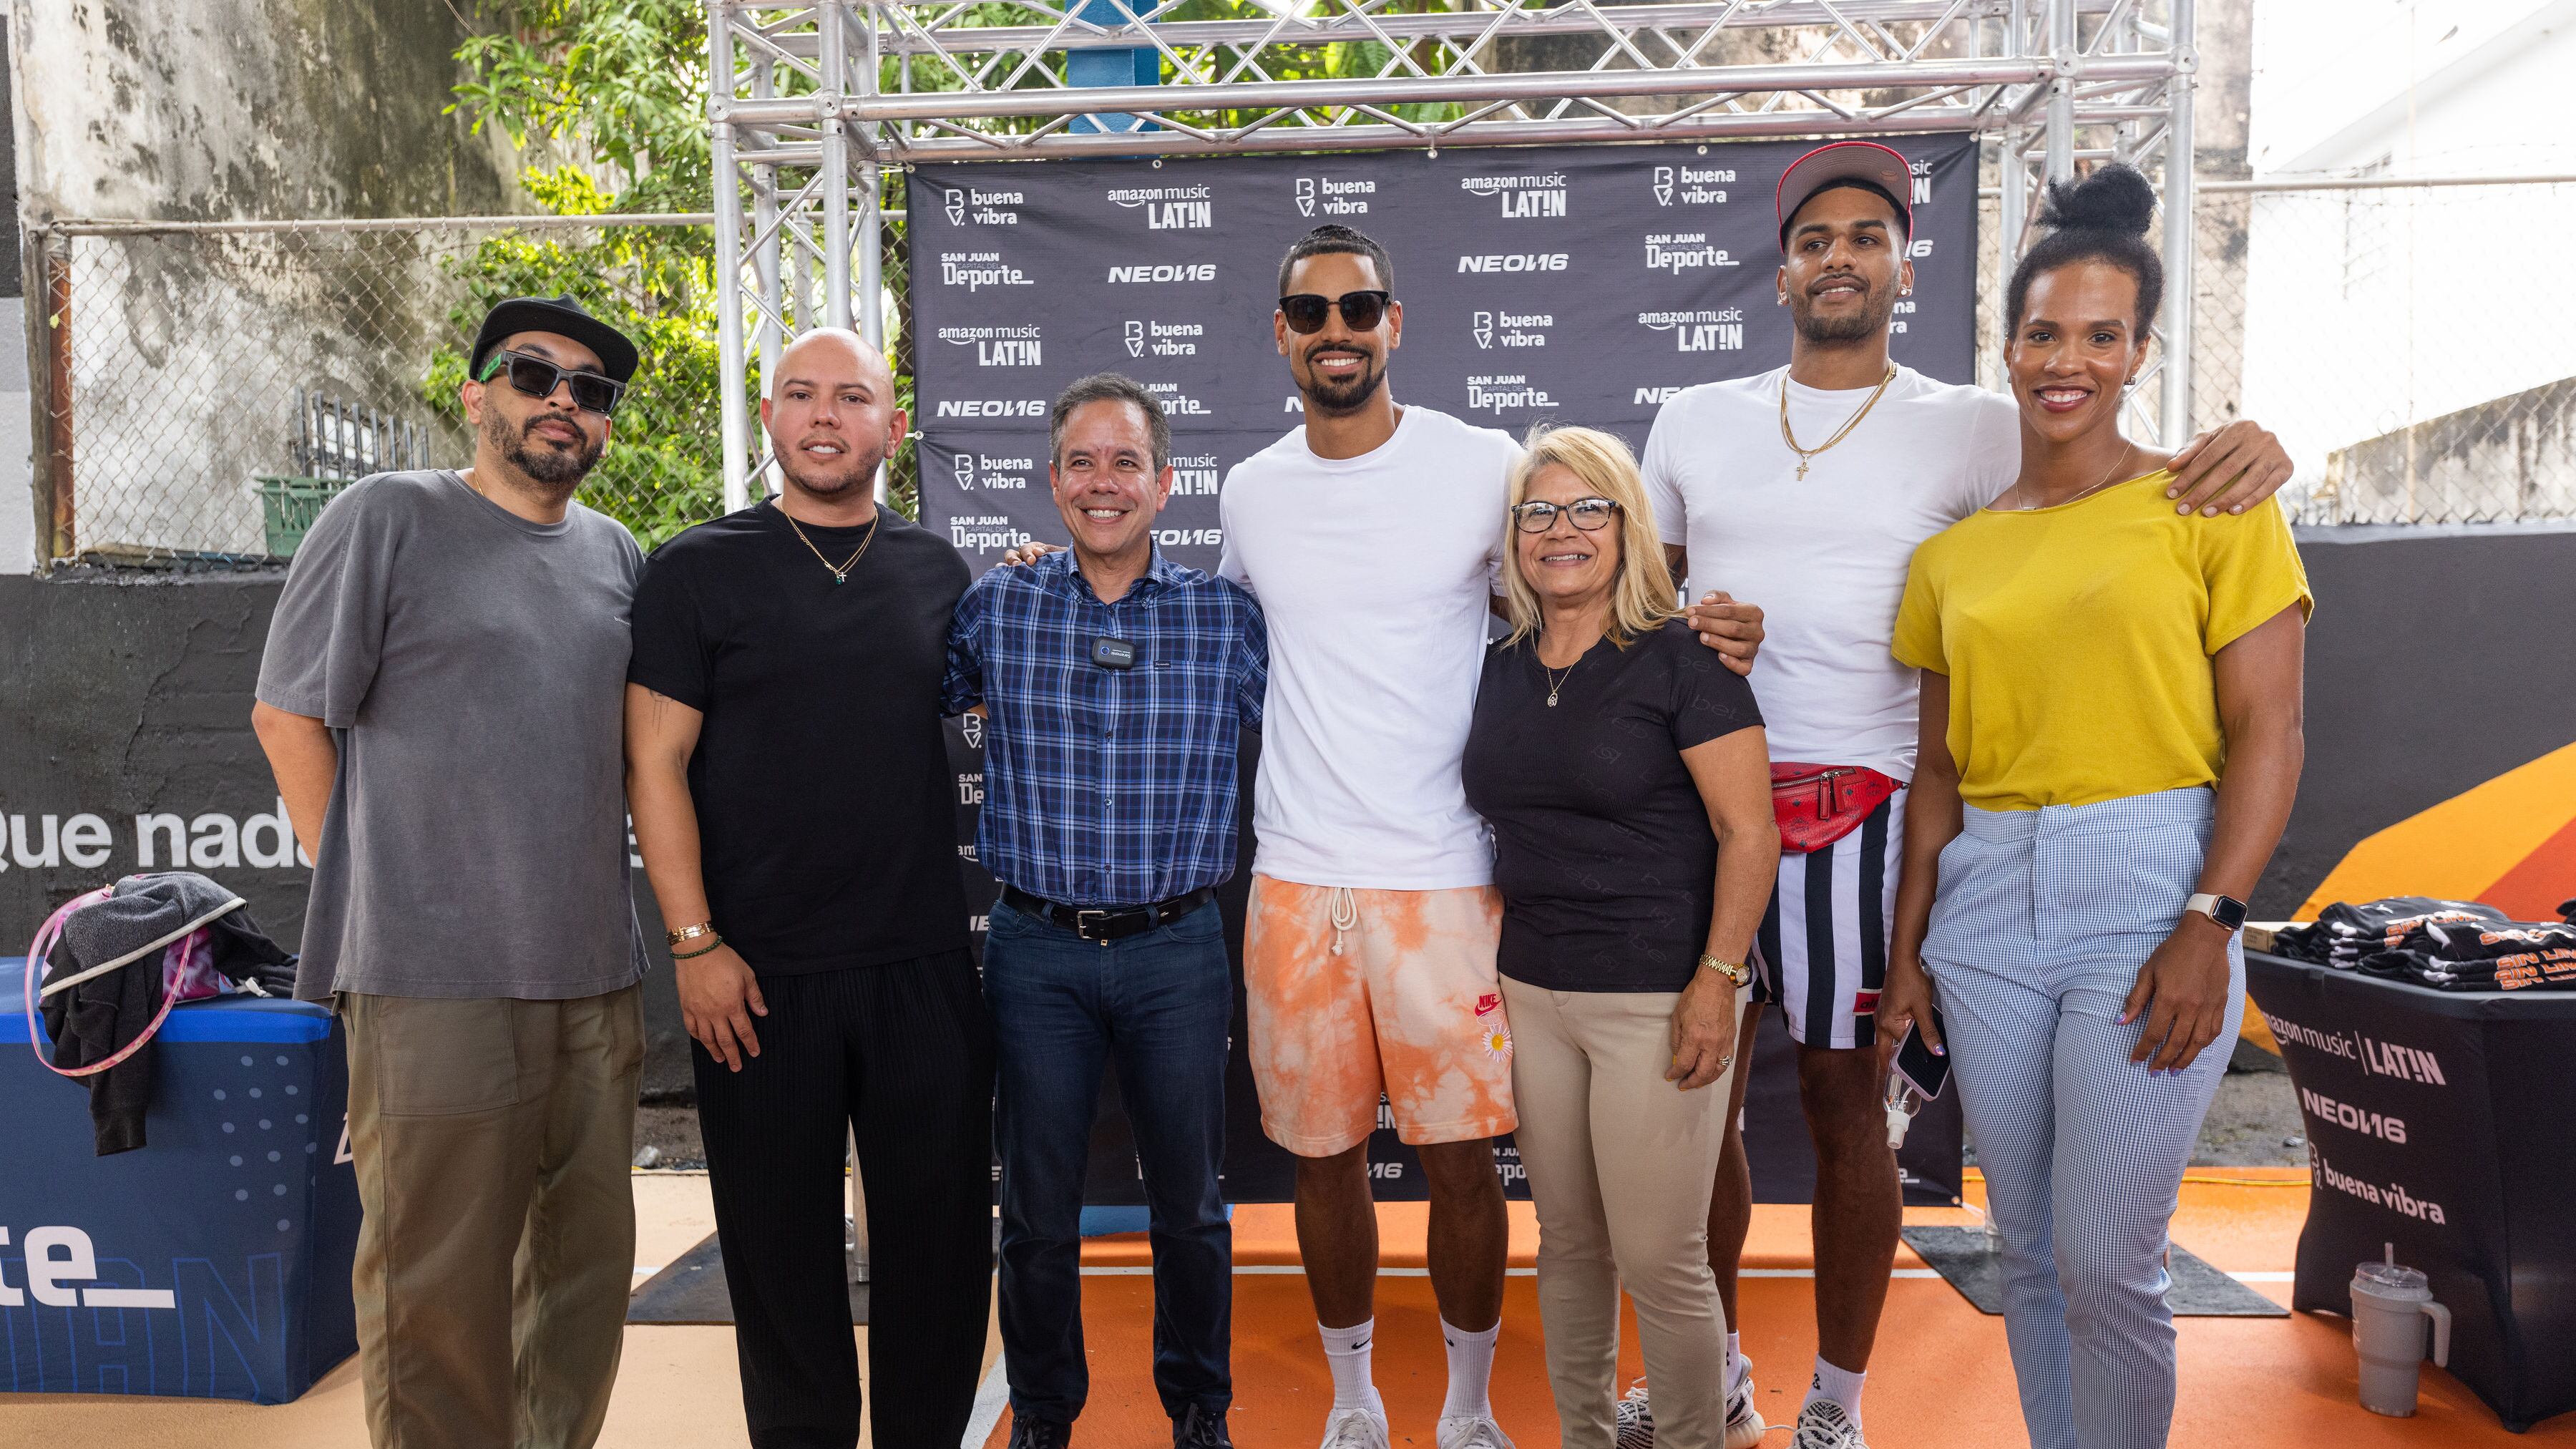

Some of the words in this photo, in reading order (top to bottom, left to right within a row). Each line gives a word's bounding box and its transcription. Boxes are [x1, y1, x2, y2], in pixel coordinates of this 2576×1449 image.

[1681, 166, 1736, 184] buena
[1911, 160, 1933, 175] sic
[1322, 177, 1376, 195] buena
[1461, 176, 1518, 189] amazon
[1520, 171, 1567, 187] music
[970, 188, 1024, 205] buena
[1107, 188, 1163, 201] amazon
[1164, 183, 1211, 200] music
[1680, 185, 1727, 204] vibra
[1322, 196, 1368, 215] vibra
[972, 207, 1018, 225] vibra
[1645, 234, 1671, 244] SAN
[1672, 233, 1706, 244] JUAN
[941, 253, 965, 263] SAN
[967, 252, 1000, 262] JUAN
[1500, 311, 1553, 328] buena
[1638, 311, 1694, 323] amazon
[1696, 306, 1743, 323] music
[938, 327, 993, 340] amazon
[995, 323, 1041, 338] music
[1151, 320, 1203, 337] buena
[1500, 329, 1545, 347] vibra
[1151, 338, 1196, 356] vibra
[1147, 383, 1178, 392] JUAN
[1467, 376, 1491, 386] SAN
[1493, 375, 1526, 385] JUAN
[980, 454, 1033, 470] buena
[1173, 453, 1217, 467] music
[981, 472, 1026, 489] vibra
[1169, 469, 1218, 495] AT!N
[950, 516, 975, 526] SAN
[976, 516, 1008, 525] JUAN
[1149, 529, 1223, 546] EON16
[958, 774, 983, 782] SAN
[0, 806, 113, 873] ue
[2496, 952, 2540, 970] SIN
[2494, 965, 2538, 981] SIN
[1478, 993, 1497, 1008] NIKE
[2262, 1010, 2303, 1043] mazon
[2302, 1026, 2356, 1060] music
[2323, 1158, 2380, 1204] buena
[2380, 1182, 2446, 1225] vibra
